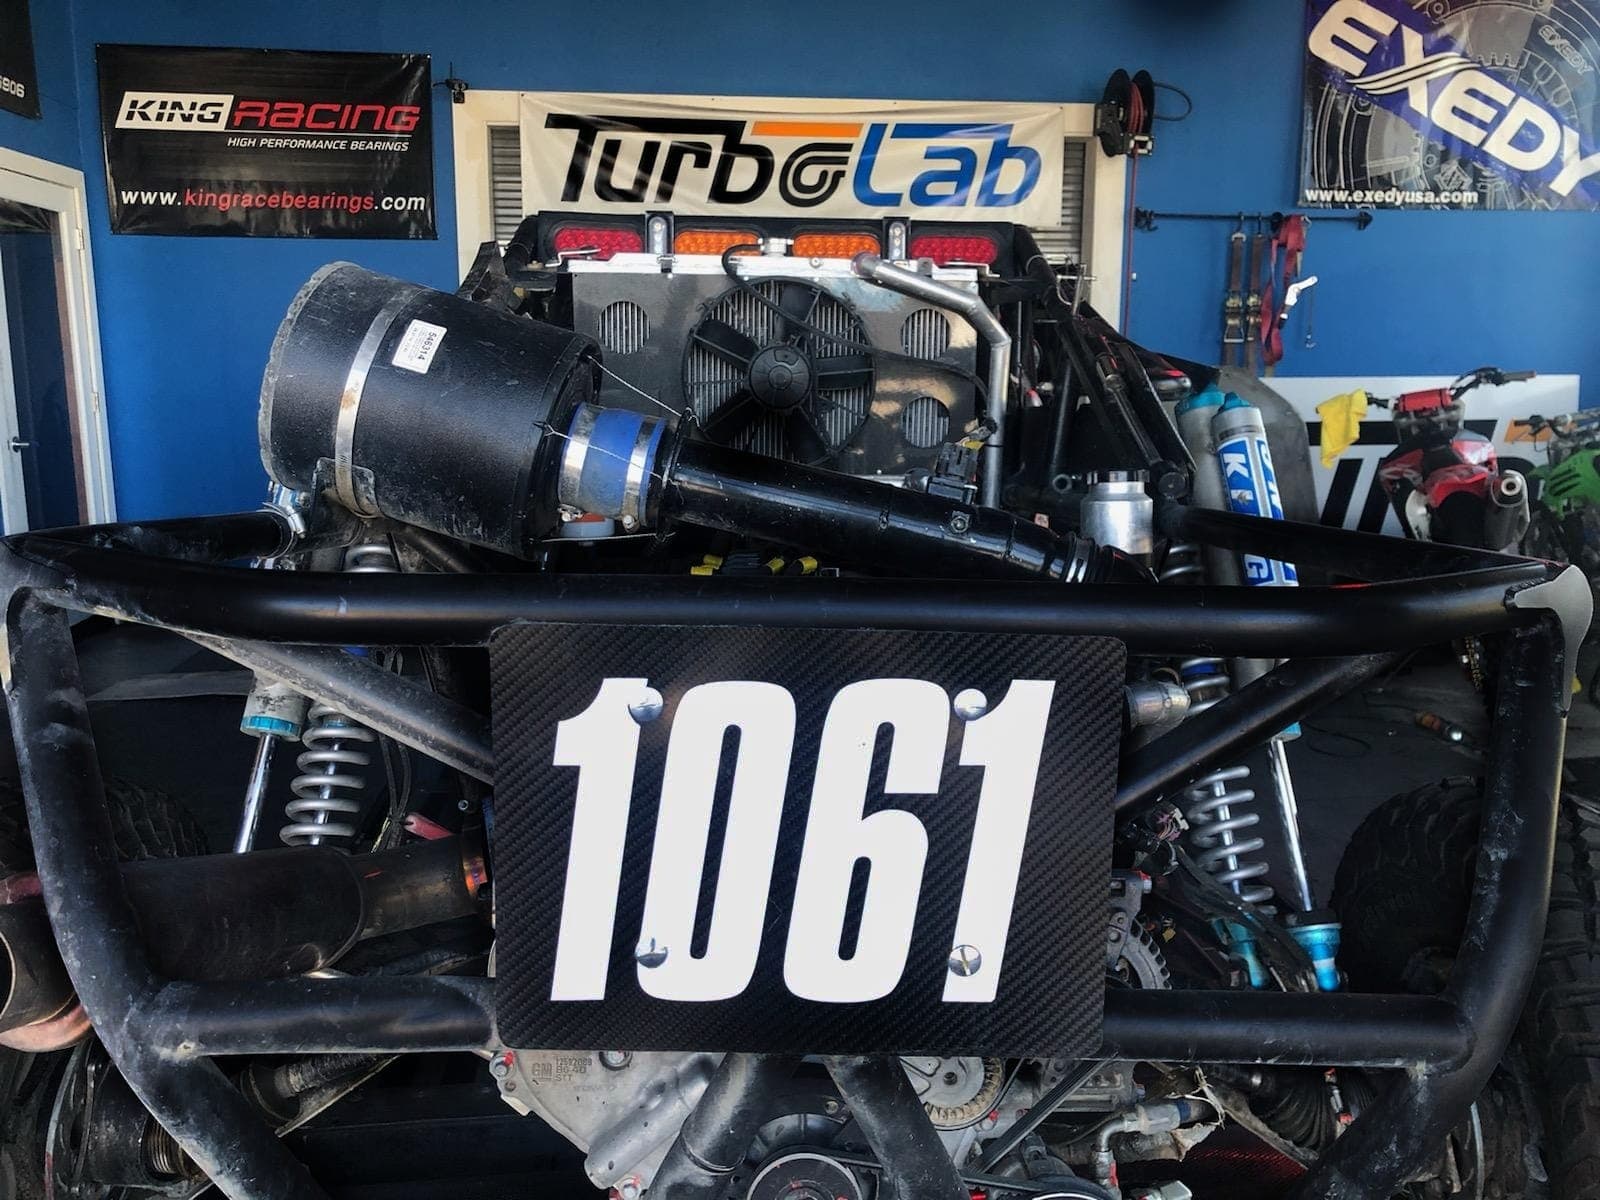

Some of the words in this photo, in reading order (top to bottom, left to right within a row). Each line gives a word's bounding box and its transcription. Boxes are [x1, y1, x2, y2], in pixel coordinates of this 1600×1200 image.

[1538, 24, 1594, 76] EXEDY
[125, 99, 225, 123] KING
[233, 101, 421, 132] RACING
[1308, 0, 1600, 197] EXEDY
[227, 137, 256, 147] HIGH
[259, 138, 347, 150] PERFORMANCE
[350, 140, 409, 151] BEARINGS
[121, 189, 426, 213] www.kingracebearings.com
[1305, 188, 1479, 206] www.exedyusa.com
[1223, 452, 1270, 579] KIG
[550, 677, 1056, 1003] 1061
